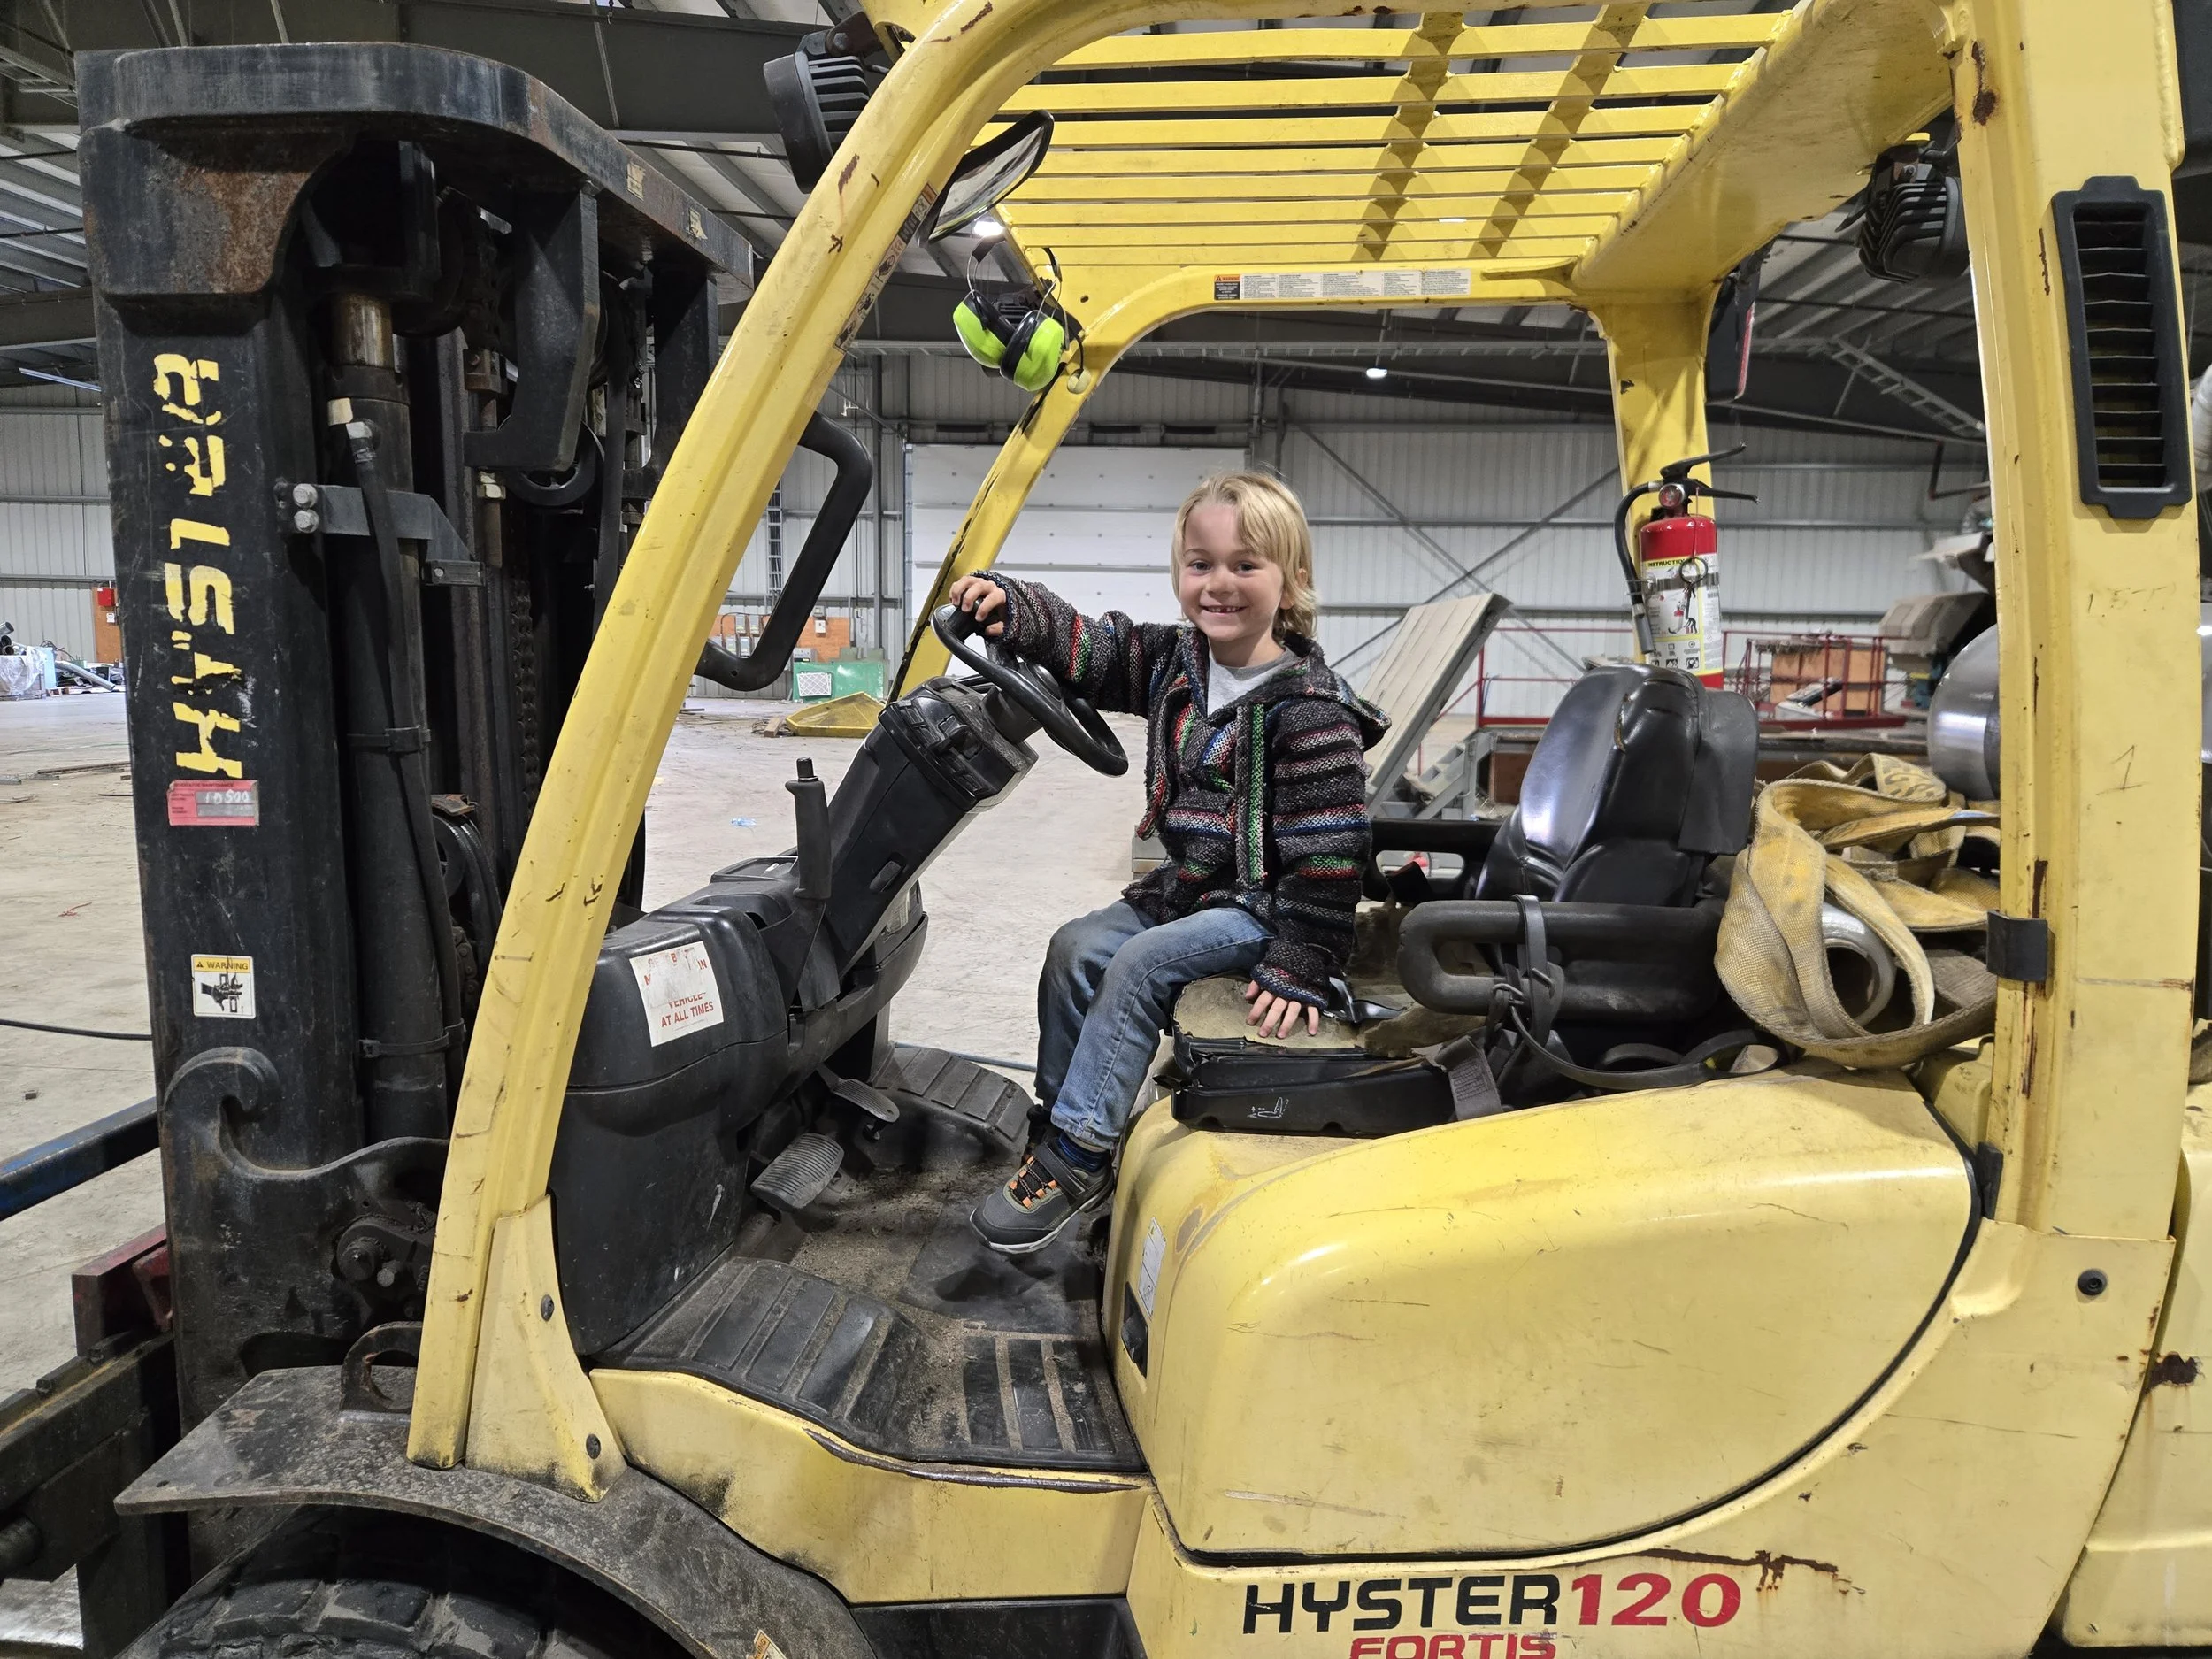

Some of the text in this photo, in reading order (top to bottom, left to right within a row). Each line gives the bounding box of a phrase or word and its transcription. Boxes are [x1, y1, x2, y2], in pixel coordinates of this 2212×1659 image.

[206, 961, 249, 970] WARNING
[661, 1015, 672, 1028] AT
[674, 1009, 689, 1024] ALL
[689, 1001, 714, 1018] TIMES
[1243, 1572, 1741, 1634] HYSTER 120
[1349, 1633, 1557, 1659] FORTIS
